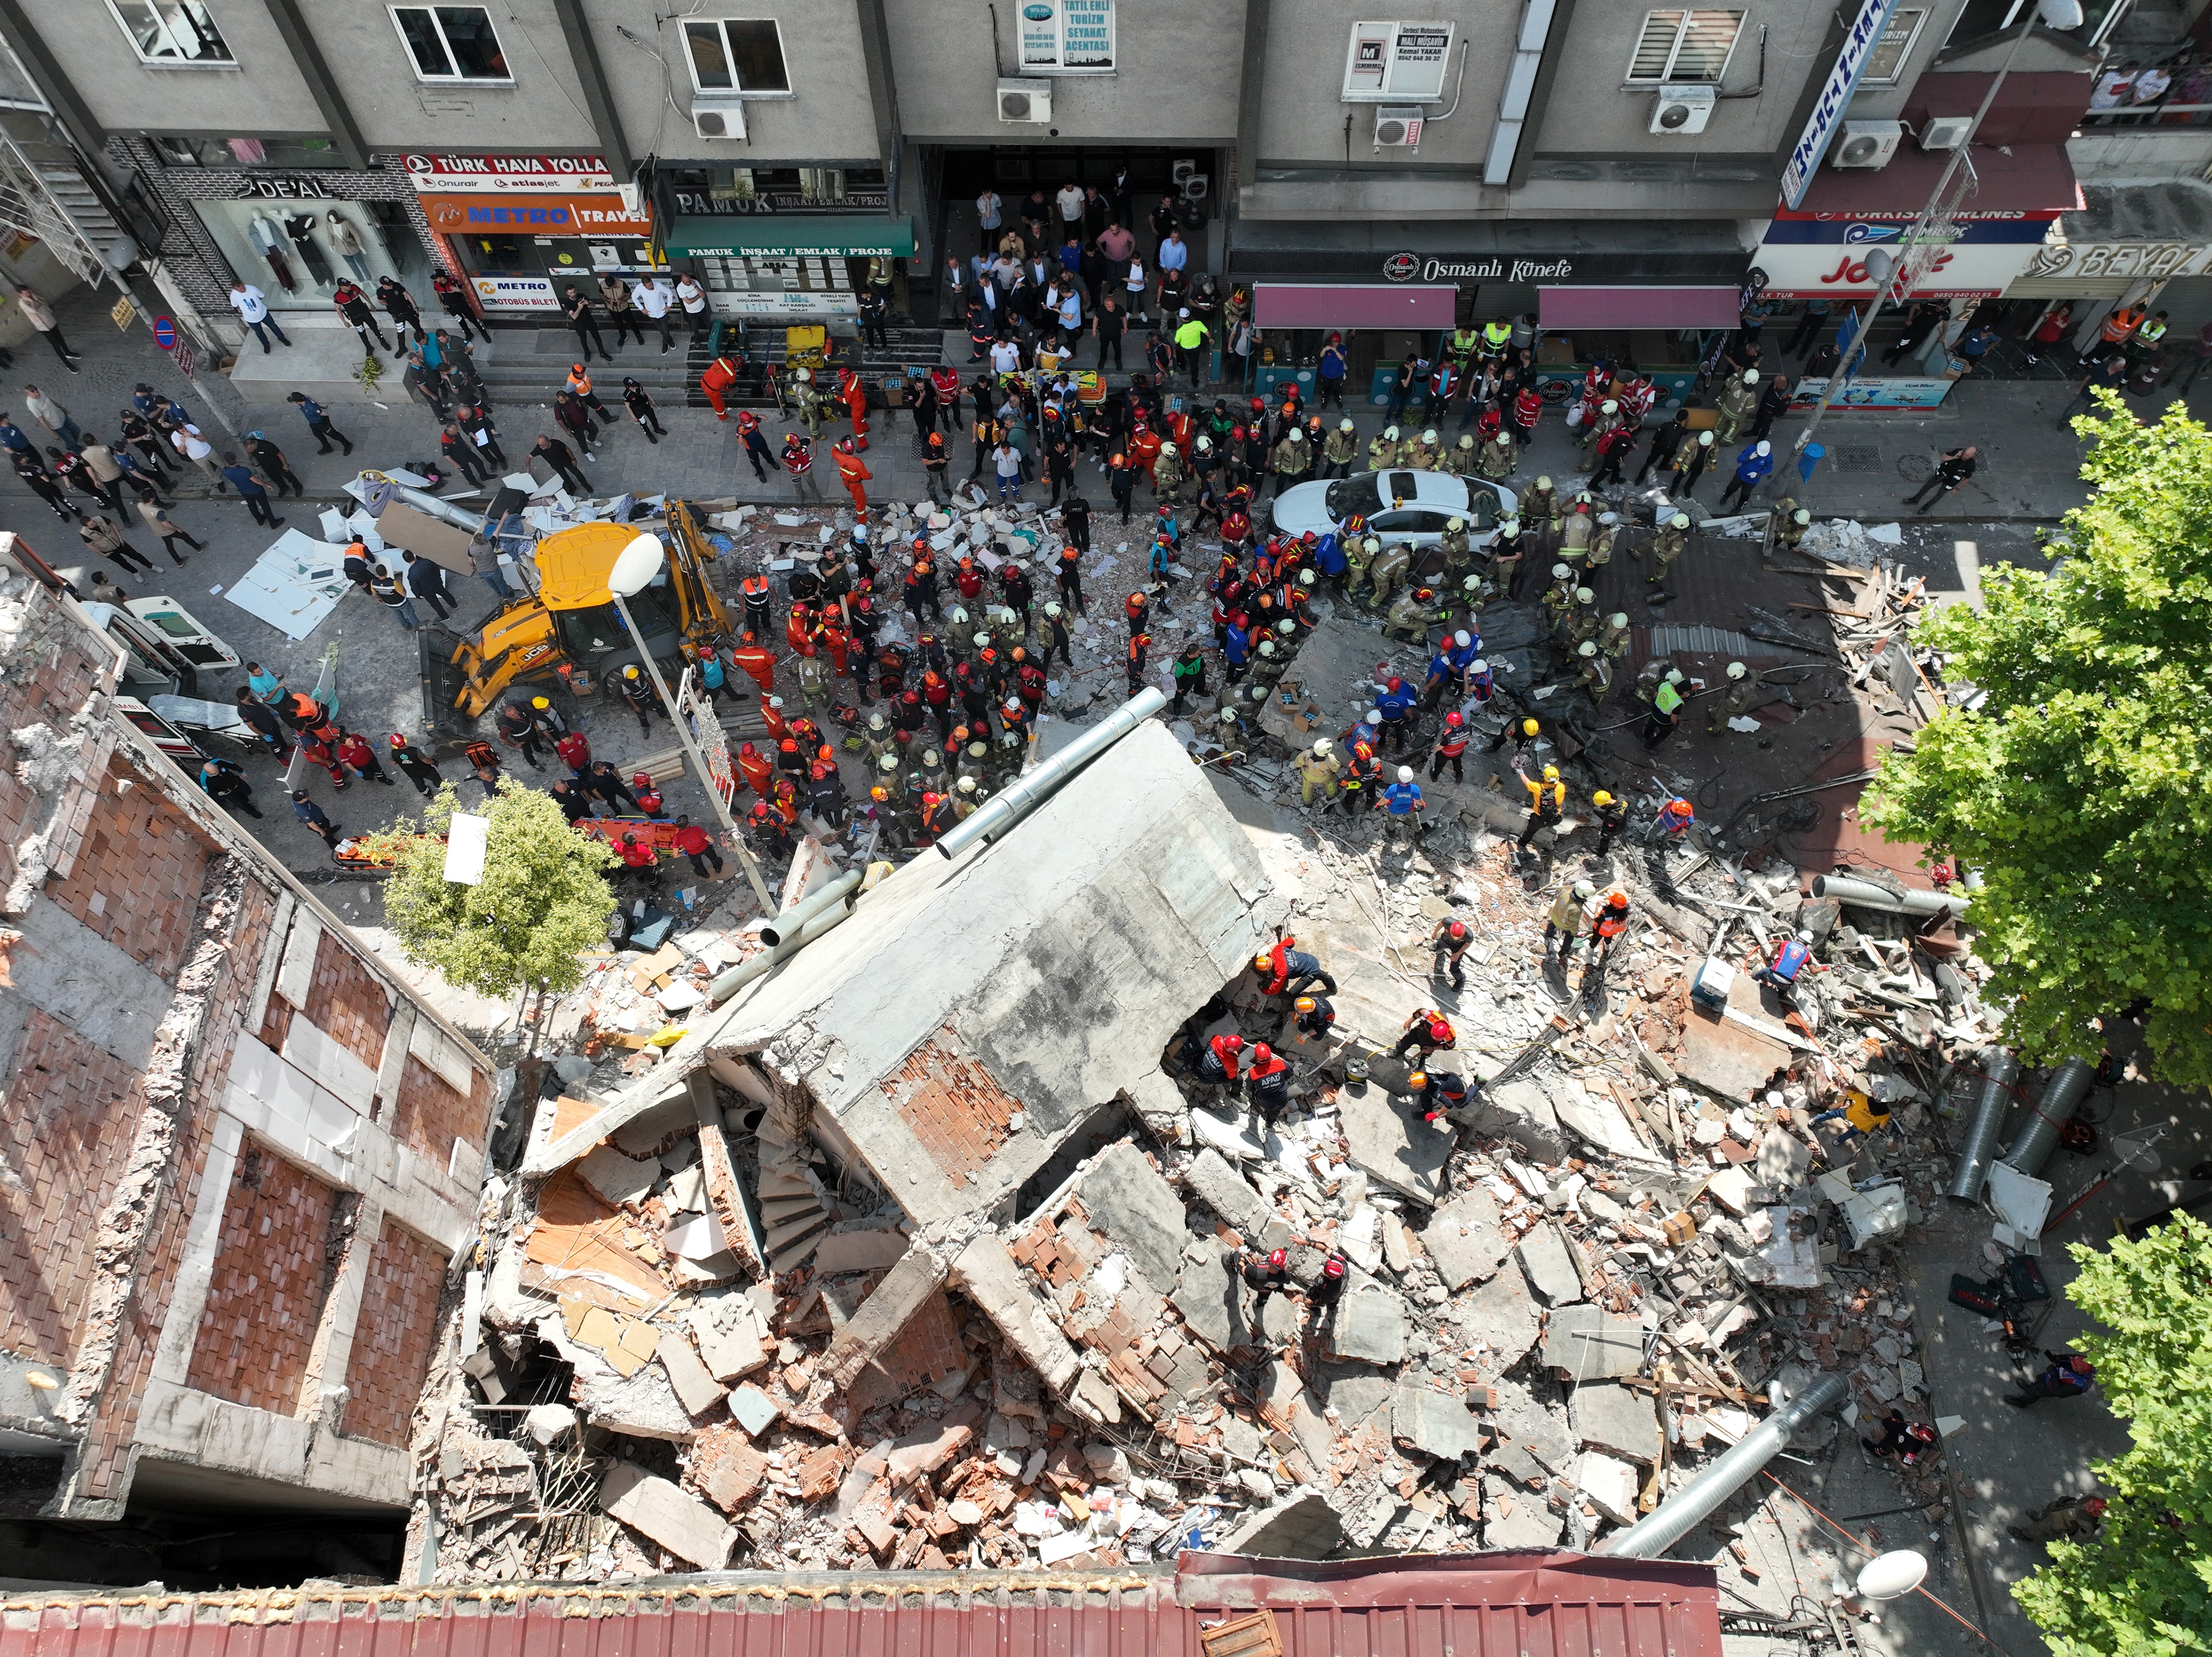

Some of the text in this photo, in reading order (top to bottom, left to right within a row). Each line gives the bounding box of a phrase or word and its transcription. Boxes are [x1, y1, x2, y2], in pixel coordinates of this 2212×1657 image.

[1064, 0, 1110, 11] TATİL EHLİ
[1070, 13, 1104, 25] TURİZM
[1068, 27, 1107, 38] SEYAHAT
[1881, 30, 1909, 40] URİZM
[1065, 41, 1109, 51] ACENTASI
[1401, 35, 1444, 46] MALİ MÜŞAVİR
[1408, 121, 1419, 144] VESTEL
[437, 154, 608, 173] TÜRK HAVA YOLLA
[511, 179, 561, 188] atlasjet
[676, 192, 772, 214] PAMUK
[467, 207, 650, 224] METRO TRAVEL
[740, 246, 786, 257] İNŞAAT
[2078, 246, 2207, 276] BEYAZ
[1423, 258, 1573, 283] Osmanlı Künefe
[532, 297, 557, 305] BİLETİ
[523, 644, 549, 662] JCB
[1285, 951, 1294, 967] AFAD
[1261, 1074, 1281, 1086] AFAD
